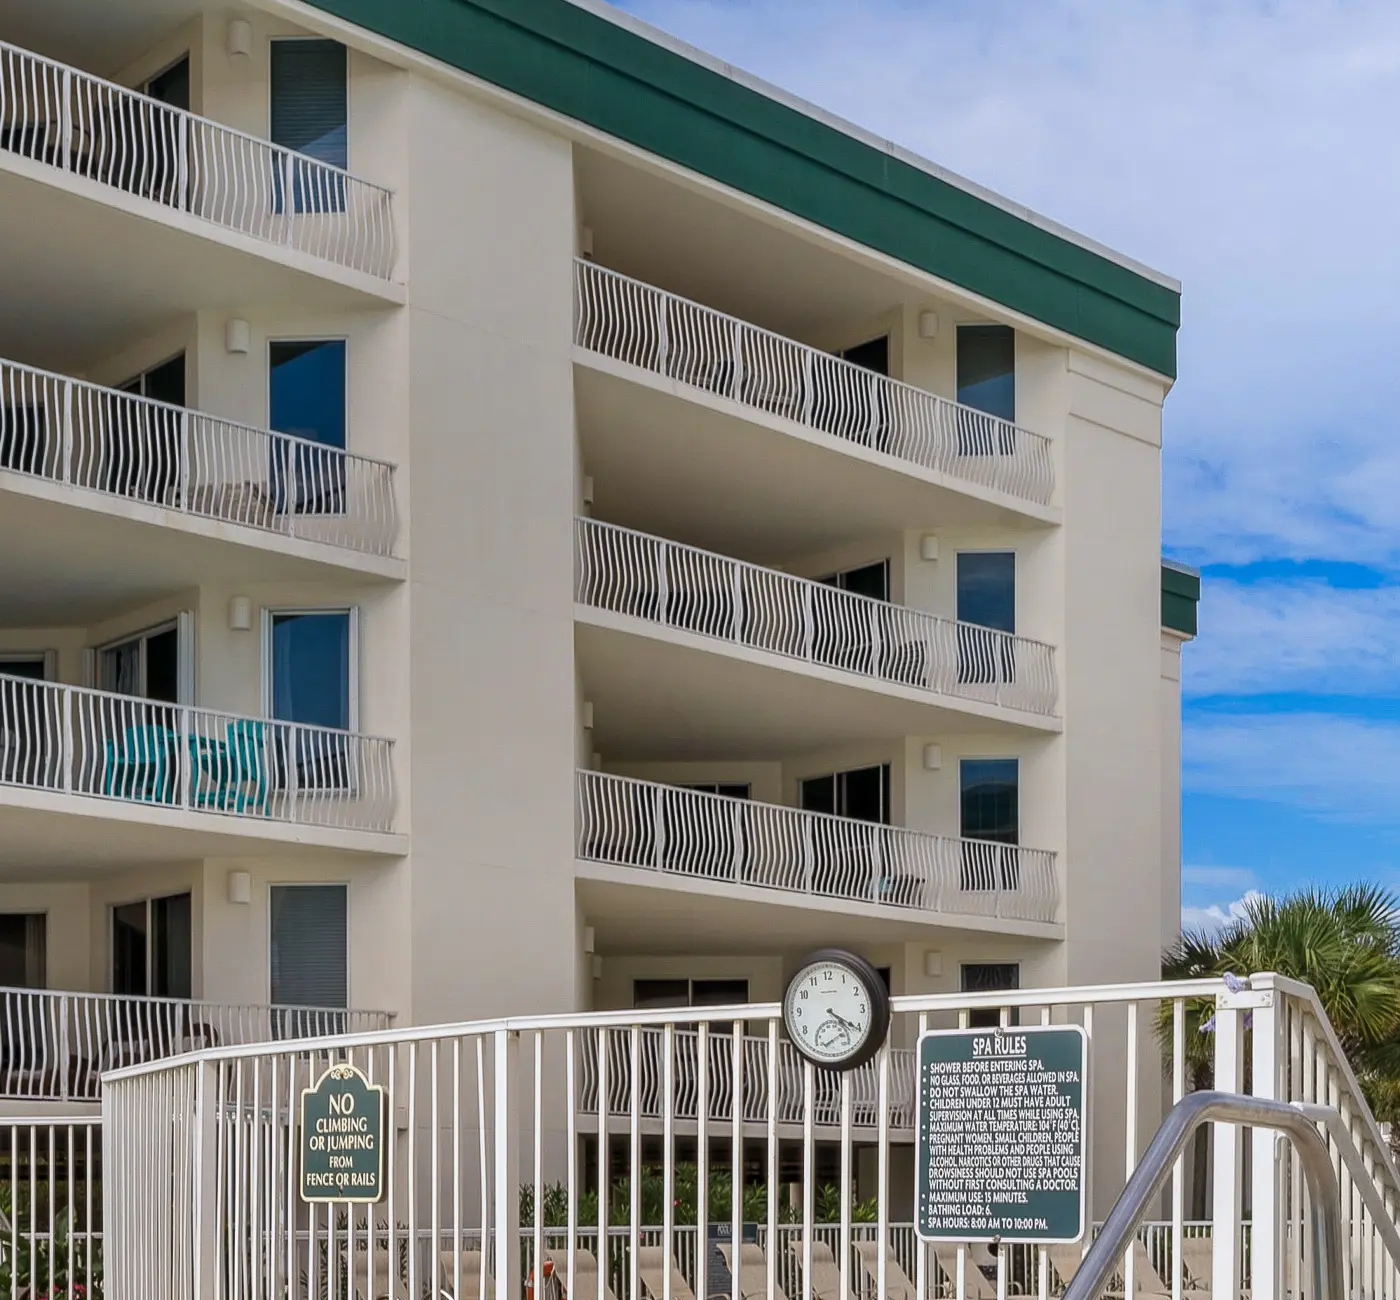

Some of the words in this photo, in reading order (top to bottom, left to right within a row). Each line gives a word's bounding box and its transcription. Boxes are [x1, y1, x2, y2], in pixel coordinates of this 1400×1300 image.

[823, 971, 832, 980] 12
[842, 975, 845, 984] 1
[809, 977, 817, 986] 11
[800, 990, 808, 999] 10
[853, 987, 859, 996] 2
[797, 1008, 802, 1016] 9
[860, 1004, 865, 1013] 3
[803, 1025, 808, 1034] 8
[973, 1038, 991, 1055] SPA
[995, 1036, 1026, 1054] RULES
[930, 1062, 961, 1073] SHOWER
[963, 1061, 989, 1072] BEFORE
[991, 1060, 1027, 1071] ENTERING
[1029, 1060, 1044, 1070] SPA.
[930, 1076, 940, 1085] NO
[941, 1075, 961, 1086] GLASS,
[962, 1074, 980, 1085] FOOD,
[981, 1074, 991, 1083] OR
[992, 1073, 1025, 1083] BEVERAGES
[1026, 1072, 1056, 1082] ALLOWED
[1058, 1072, 1065, 1082] IN
[1066, 1072, 1079, 1082] SPA.
[930, 1088, 941, 1097] DO
[943, 1087, 959, 1097] NOT
[960, 1086, 999, 1096] SWALLOW
[1000, 1086, 1013, 1095] THE
[1015, 1085, 1028, 1095] SPA
[1030, 1085, 1058, 1095] WATER.
[329, 1093, 354, 1115] NO
[930, 1099, 965, 1109] CHILDREN
[966, 1098, 991, 1108] UNDER
[993, 1098, 999, 1107] 12
[1001, 1097, 1023, 1107] MUST
[1024, 1097, 1044, 1107] HAVE
[1045, 1096, 1071, 1106] ADULT
[929, 1111, 972, 1121] SUPERVISION
[973, 1111, 983, 1120] AT
[984, 1110, 996, 1120] ALL
[997, 1110, 1017, 1119] TIMES
[1019, 1109, 1039, 1119] WHILE
[1041, 1109, 1063, 1119] USING
[1065, 1108, 1079, 1119] SPA.
[316, 1117, 367, 1132] CLIMBING
[929, 1122, 963, 1132] MAXIMUM
[964, 1122, 988, 1131] WATER
[989, 1121, 1037, 1131] TEMPERATURE:
[309, 1136, 325, 1150] OR
[327, 1135, 373, 1152] JUMPING
[929, 1133, 964, 1144] PREGNANT
[965, 1133, 993, 1144] WOMEN,
[995, 1133, 1017, 1143] SMALL
[1054, 1132, 1079, 1142] PEOPLE
[929, 1146, 947, 1155] WITH
[948, 1145, 973, 1155] HEALTH
[974, 1145, 1008, 1154] PROBLEMS
[1010, 1144, 1025, 1154] AND
[1026, 1144, 1050, 1154] PEOPLE
[1051, 1144, 1073, 1154] USING
[329, 1156, 352, 1168] FROM
[958, 1157, 991, 1167] NARCOTICS
[992, 1157, 1001, 1166] OR
[1001, 1156, 1021, 1166] OTHER
[1023, 1156, 1042, 1166] DRUGS
[1044, 1156, 1060, 1166] THAT
[1061, 1156, 1080, 1166] CAUSE
[929, 1169, 974, 1178] DROWSINESS
[975, 1168, 1004, 1178] SHOULD
[1006, 1168, 1021, 1178] NOT
[1023, 1168, 1037, 1178] USE
[1038, 1168, 1051, 1178] SPA
[1053, 1168, 1078, 1178] POOLS
[307, 1173, 333, 1186] FENCE
[336, 1173, 349, 1185] OR
[352, 1173, 375, 1185] RAILS
[929, 1180, 964, 1190] WITHOUT
[965, 1180, 985, 1190] FIRST
[986, 1180, 1034, 1190] CONSULTING
[1036, 1180, 1041, 1190] A
[1043, 1179, 1078, 1190] DOCTOR.
[929, 1192, 966, 1203] MAXIMUM
[968, 1192, 983, 1202] USE:
[985, 1192, 991, 1202] 15
[993, 1192, 1028, 1203] MINUTES.
[928, 1205, 960, 1215] BATHING
[962, 1205, 984, 1215] LOAD:
[985, 1205, 992, 1215] 6.
[928, 1219, 942, 1228] SPA
[943, 1219, 970, 1228] HOURS:
[971, 1219, 986, 1229] 8:00
[988, 1219, 1000, 1229] AM
[1002, 1219, 1012, 1229] TO
[1014, 1218, 1033, 1229] 10:00
[1034, 1219, 1048, 1230] PM.
